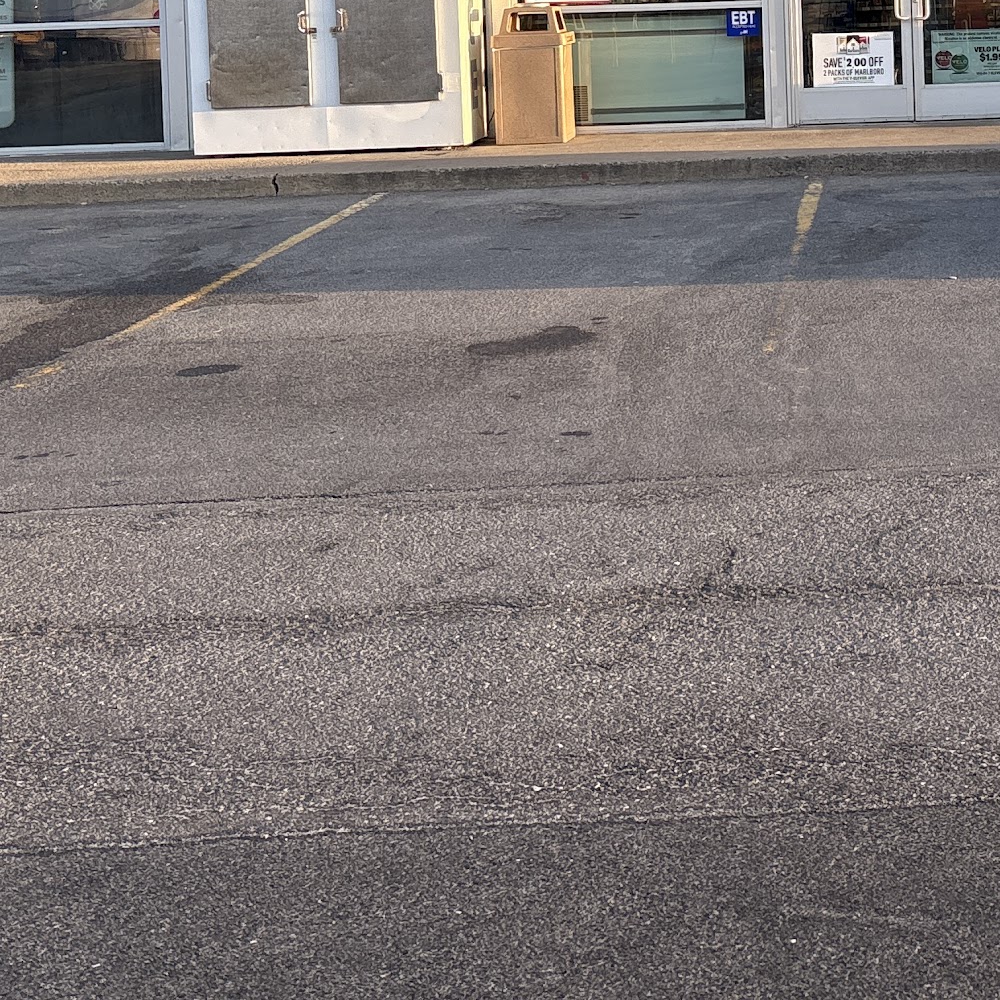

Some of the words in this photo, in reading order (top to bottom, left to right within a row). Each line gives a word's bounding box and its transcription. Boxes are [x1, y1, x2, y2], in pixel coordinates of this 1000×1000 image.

[730, 10, 756, 25] EBT
[823, 57, 843, 68] SAVE
[868, 56, 884, 67] OFF
[854, 67, 884, 75] MARLBORO
